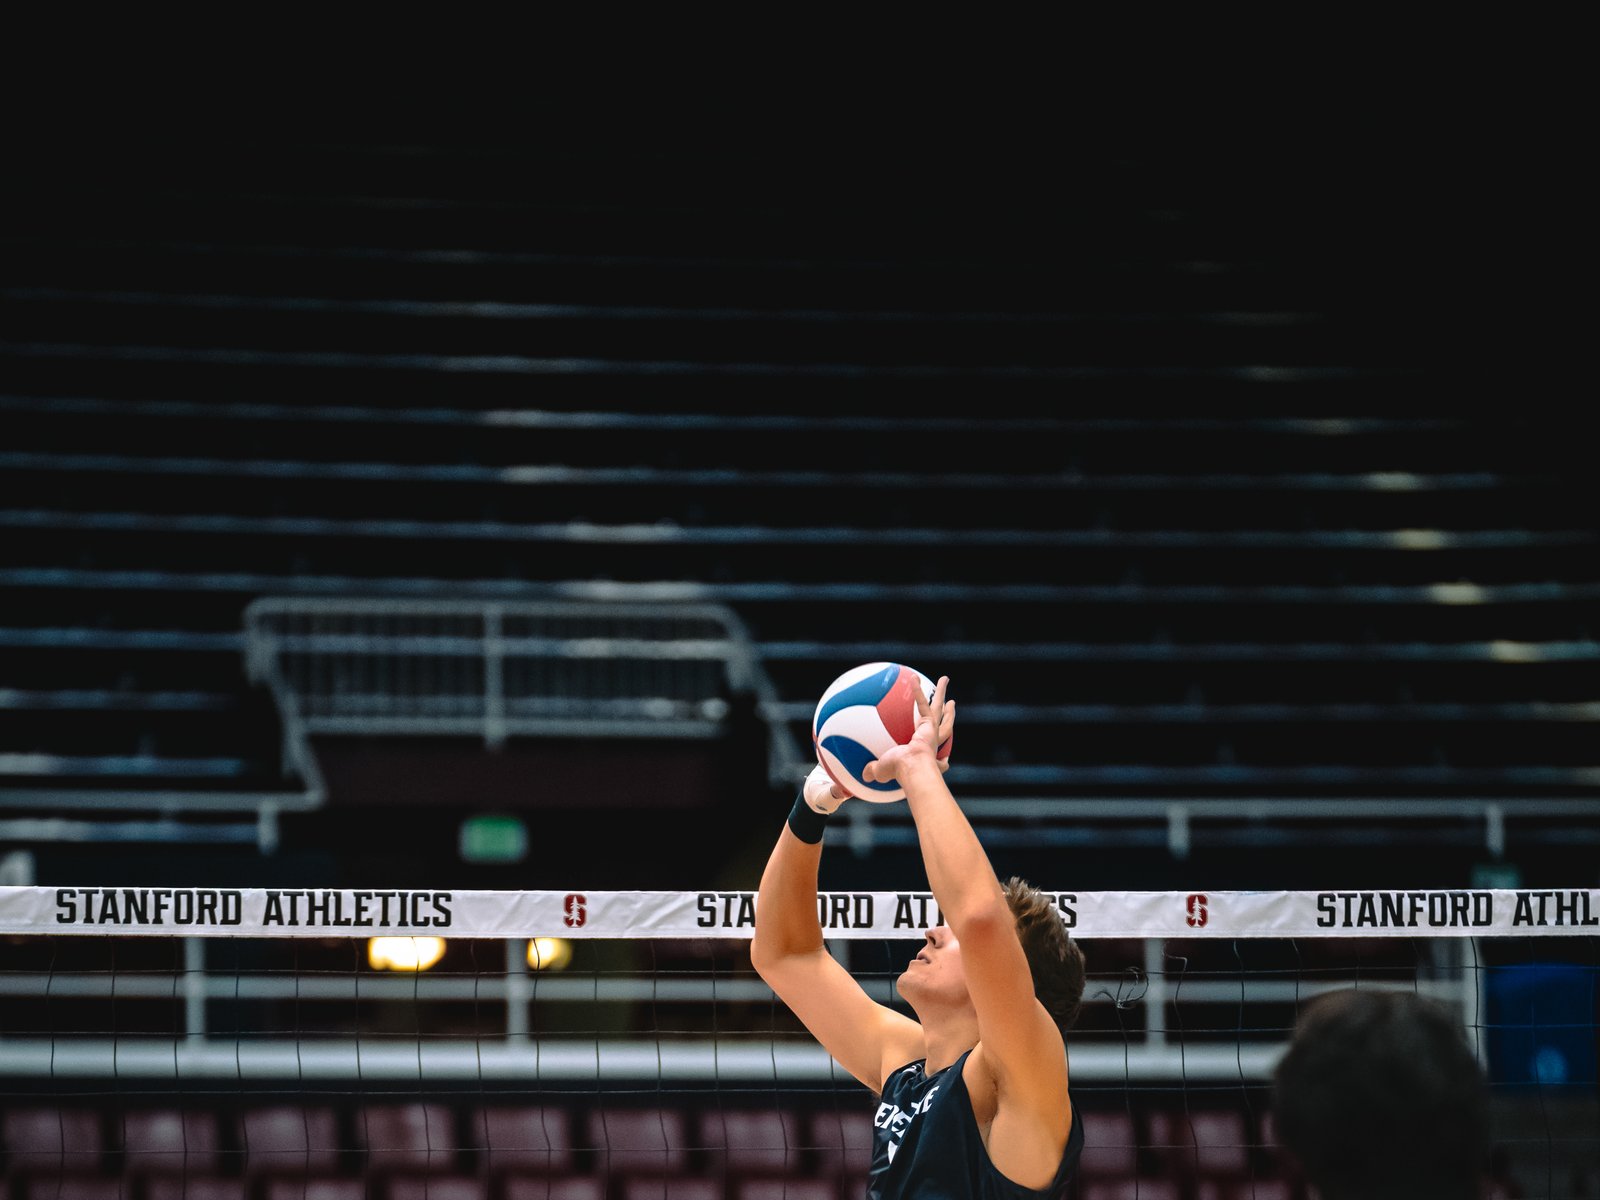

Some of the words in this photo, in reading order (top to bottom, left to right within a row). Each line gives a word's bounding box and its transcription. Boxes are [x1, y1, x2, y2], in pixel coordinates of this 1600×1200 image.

[56, 889, 241, 925] STANFORD
[263, 891, 452, 927] ATHLETICS
[697, 893, 873, 928] STARD
[1316, 892, 1493, 927] STANFORD
[1512, 892, 1599, 926] ATHL
